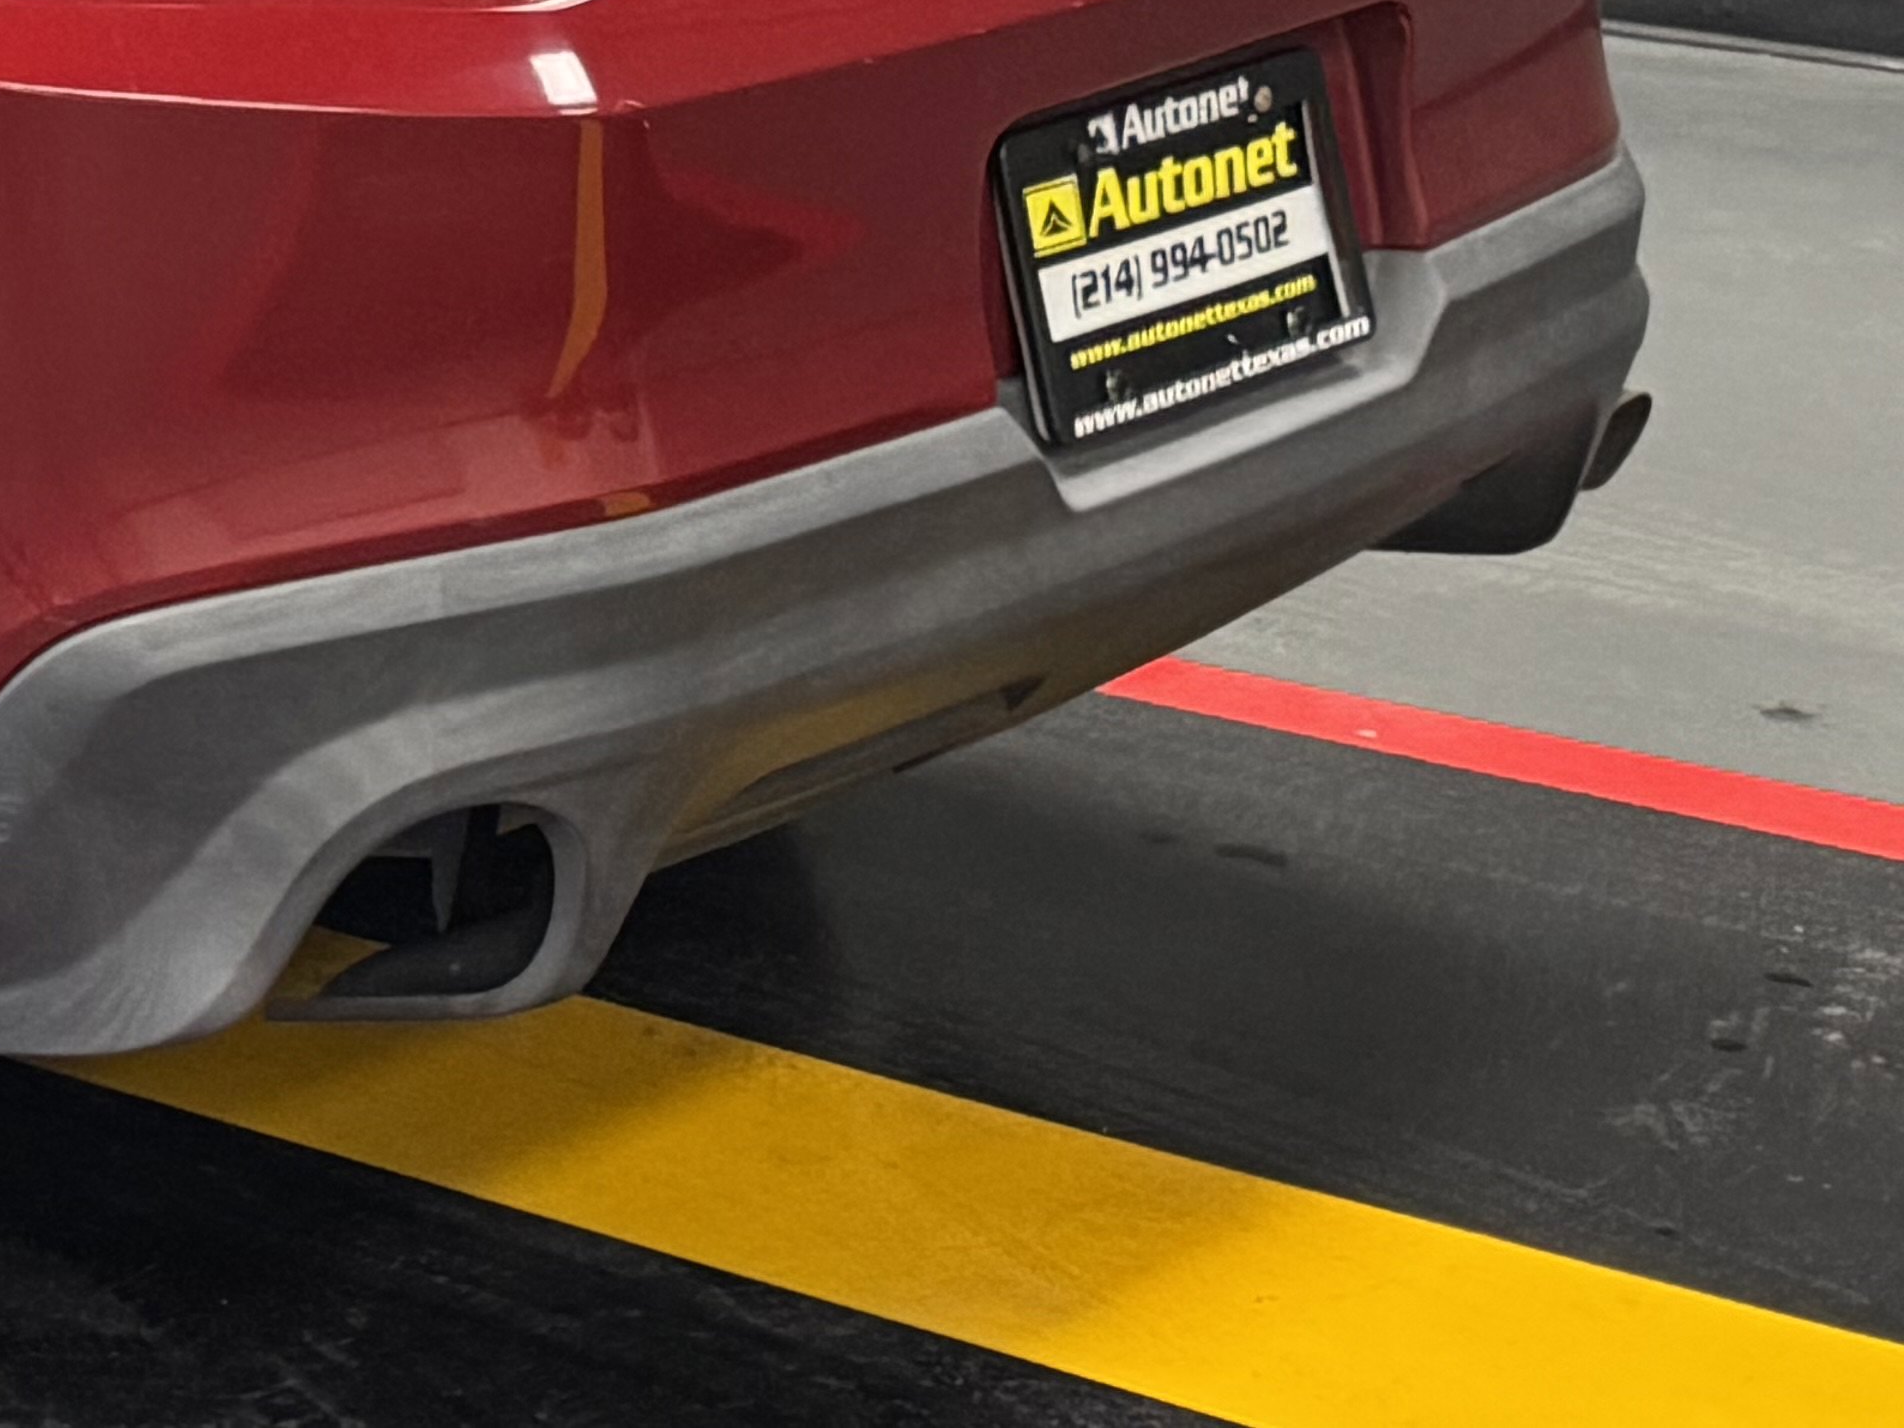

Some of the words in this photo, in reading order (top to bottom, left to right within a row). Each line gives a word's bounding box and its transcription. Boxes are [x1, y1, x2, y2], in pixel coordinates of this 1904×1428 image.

[1122, 75, 1250, 150] Autonet
[1089, 121, 1299, 239] Autonet
[1072, 253, 1143, 320] (214)
[1151, 209, 1291, 289] 994-0502
[1070, 273, 1318, 371] www.autonettexas.com
[1074, 315, 1371, 439] www.autonettexas.com
